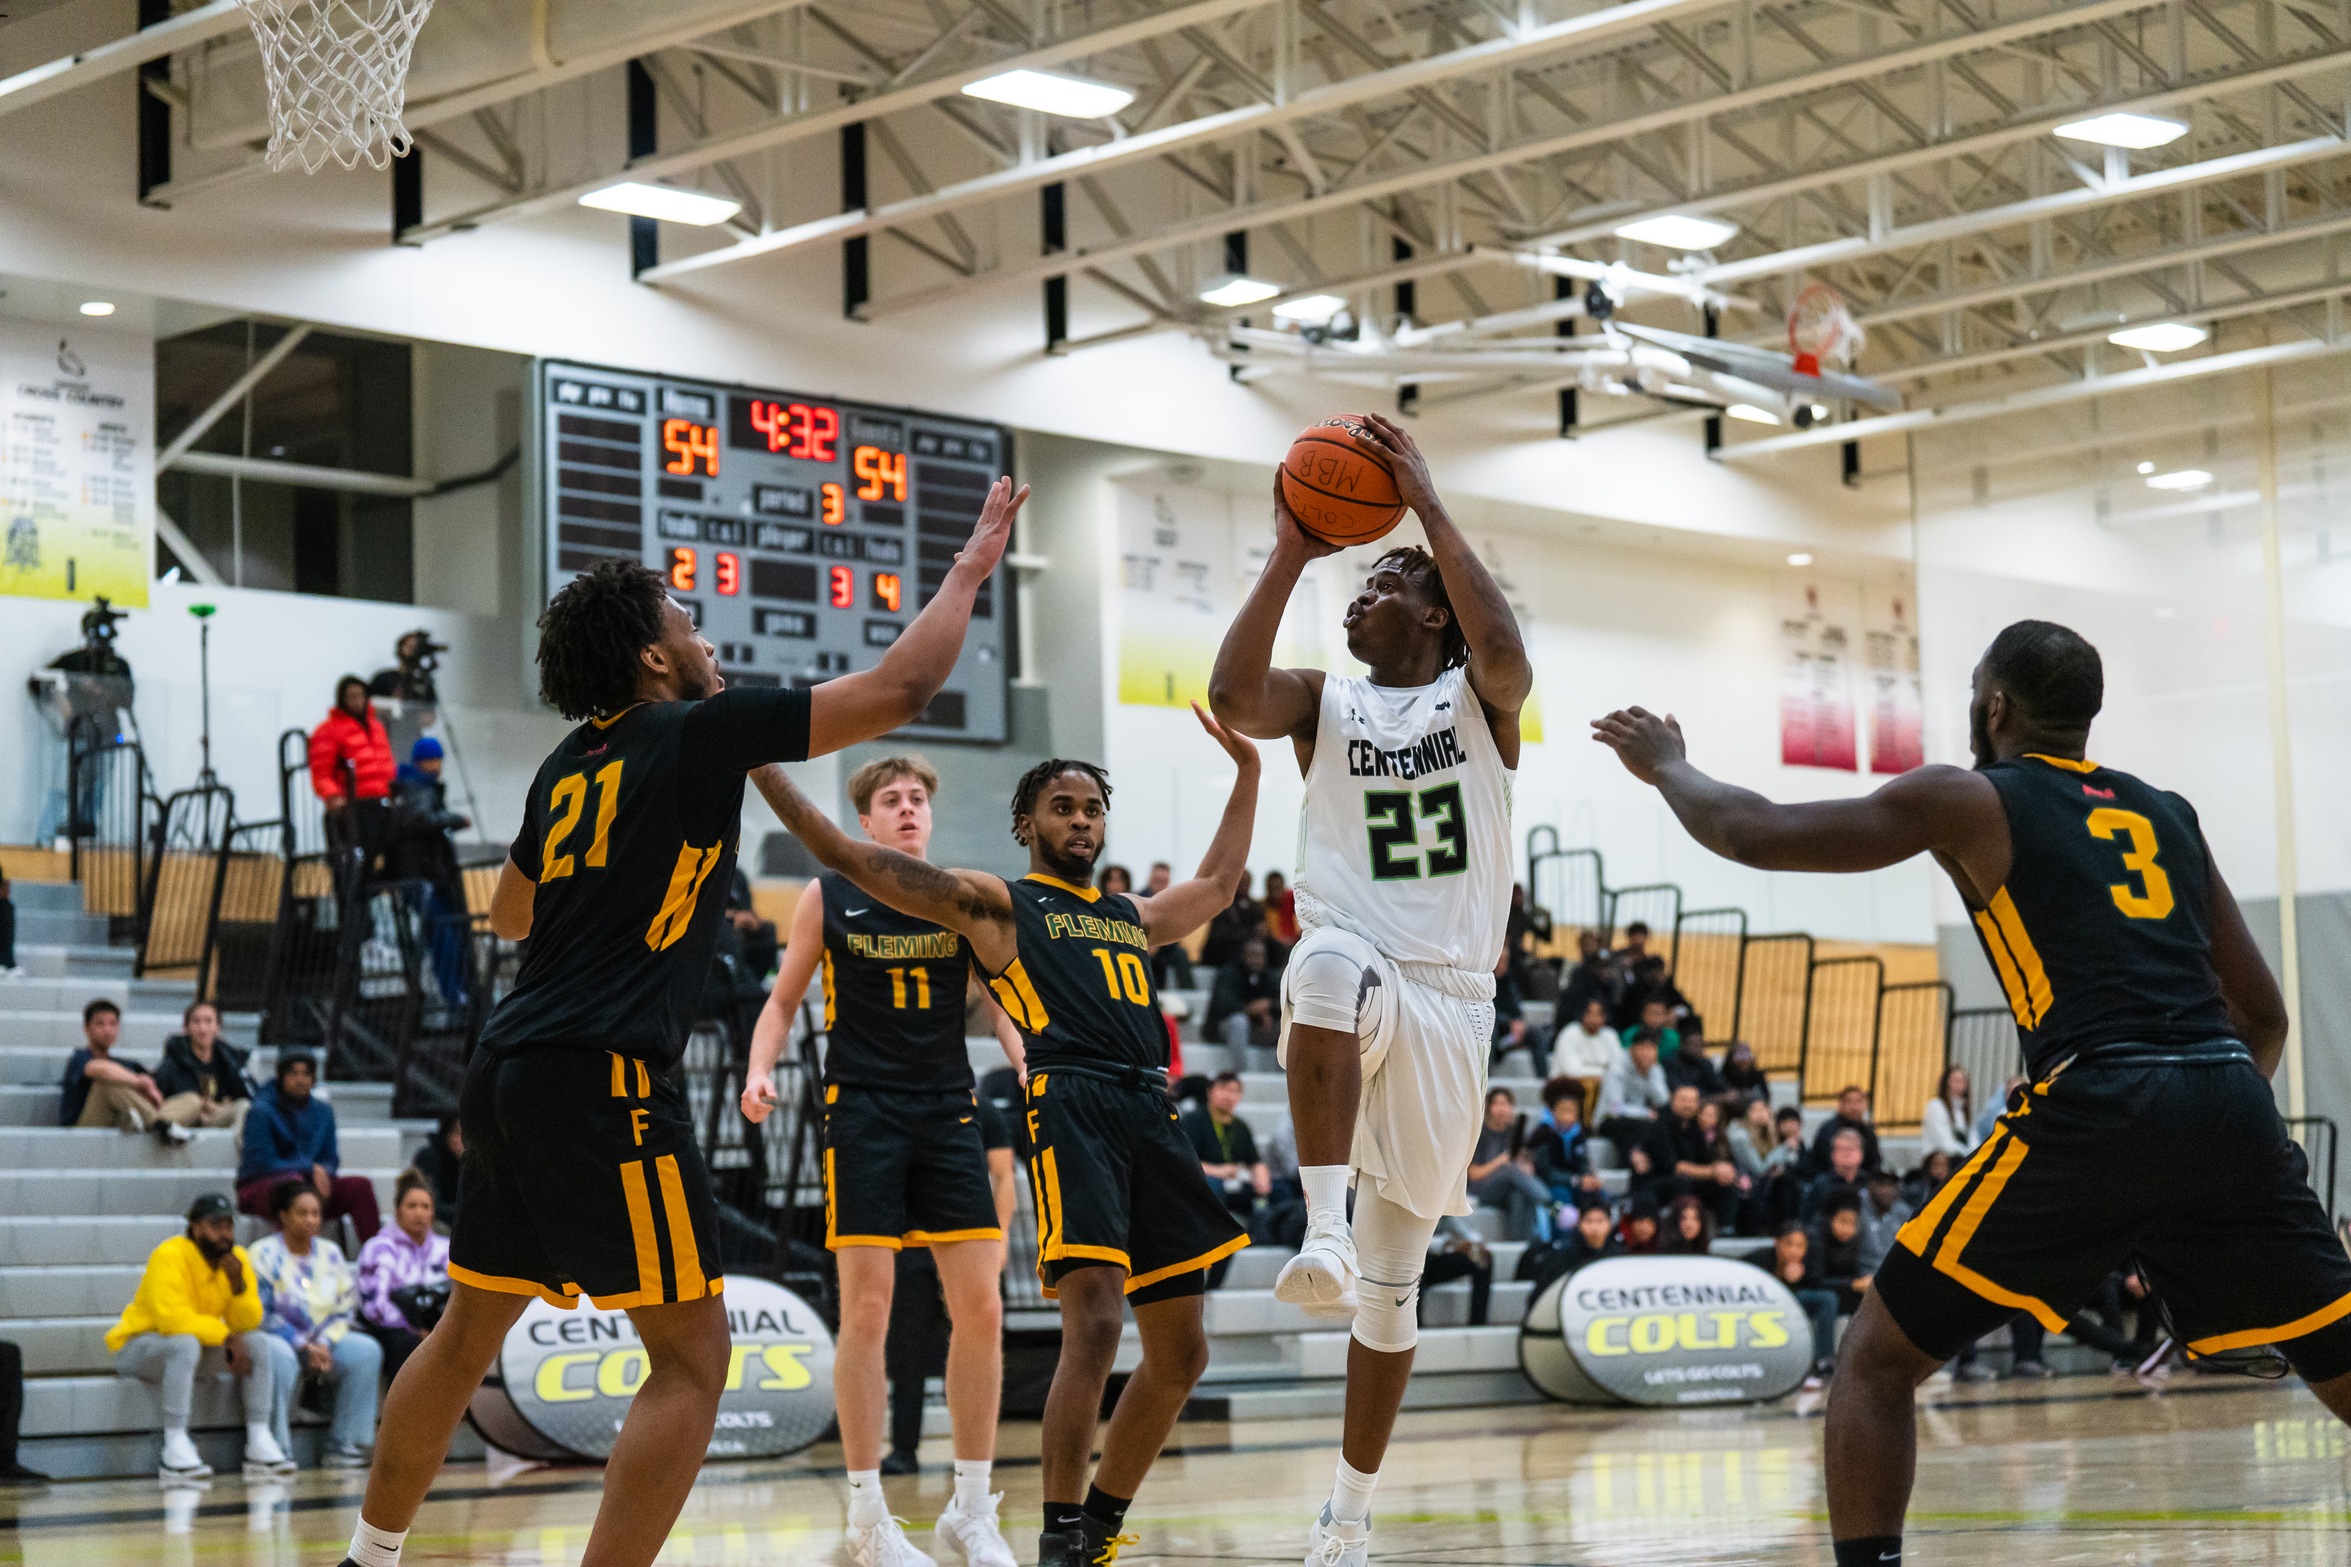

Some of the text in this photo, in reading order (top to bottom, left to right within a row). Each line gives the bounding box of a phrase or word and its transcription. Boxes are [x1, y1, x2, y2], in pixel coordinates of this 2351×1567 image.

[664, 418, 719, 477] 54
[750, 399, 839, 462] 4:32
[854, 445, 908, 502] 54
[1299, 450, 1364, 493] MBB
[822, 483, 845, 526] 3
[1291, 492, 1354, 529] COLTS
[672, 547, 697, 591] 2
[716, 552, 740, 596] 3
[831, 565, 854, 609] 3
[876, 573, 901, 612] 4
[1347, 725, 1467, 780] CENTENNIAL
[539, 759, 624, 885] 21
[1364, 780, 1469, 881] 23
[2086, 807, 2175, 920] 3
[847, 932, 959, 959] FLEMING
[1045, 913, 1148, 952] FLEMING
[885, 966, 931, 1009] 11
[1092, 948, 1150, 1007] 10
[630, 1108, 650, 1147] F
[1027, 1109, 1040, 1144] F
[1577, 1284, 1776, 1311] CENTENNIAL
[528, 1309, 805, 1346] CENTIAL
[1586, 1310, 1790, 1357] COLTS
[533, 1342, 816, 1402] COTS
[714, 1411, 775, 1429] OLTS
